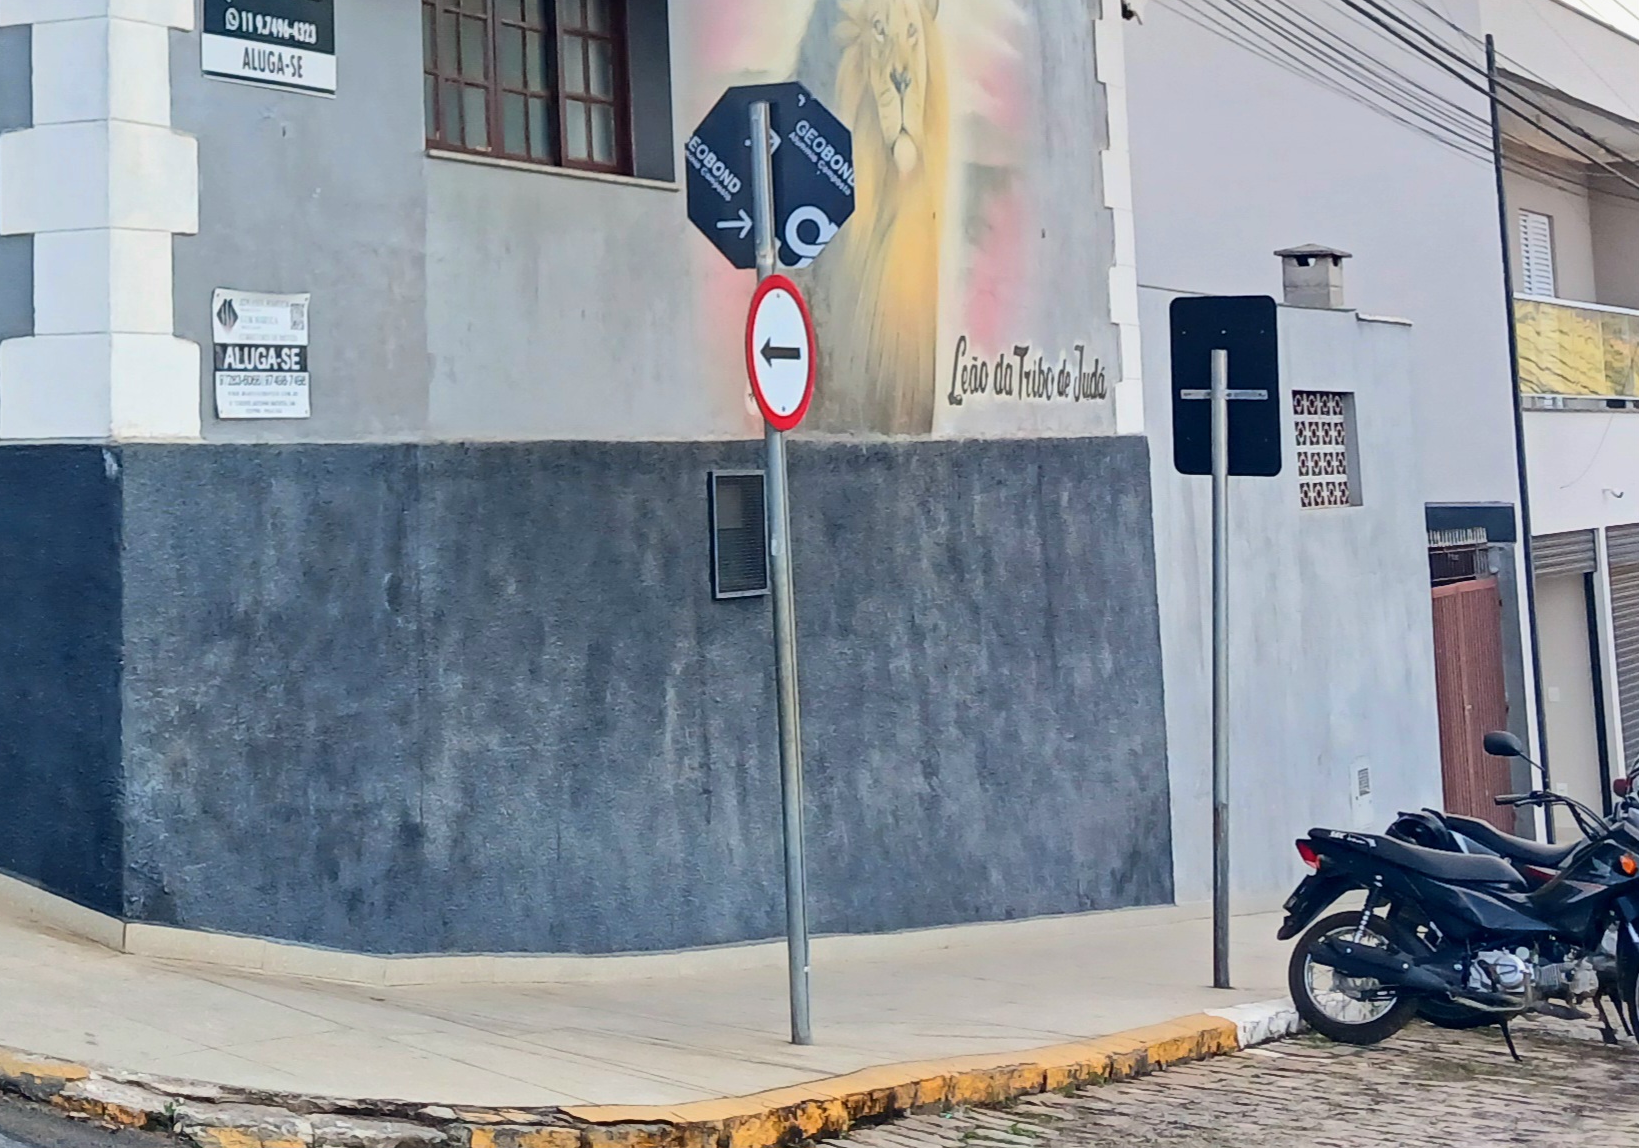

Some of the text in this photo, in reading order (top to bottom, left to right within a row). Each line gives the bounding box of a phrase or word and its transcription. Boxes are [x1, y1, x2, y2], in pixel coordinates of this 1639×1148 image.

[241, 10, 253, 34] 11
[242, 46, 304, 79] ALUGA-SE
[223, 345, 301, 370] ALUGA-SE
[947, 335, 1108, 405] Leão da Tribo de Judá
